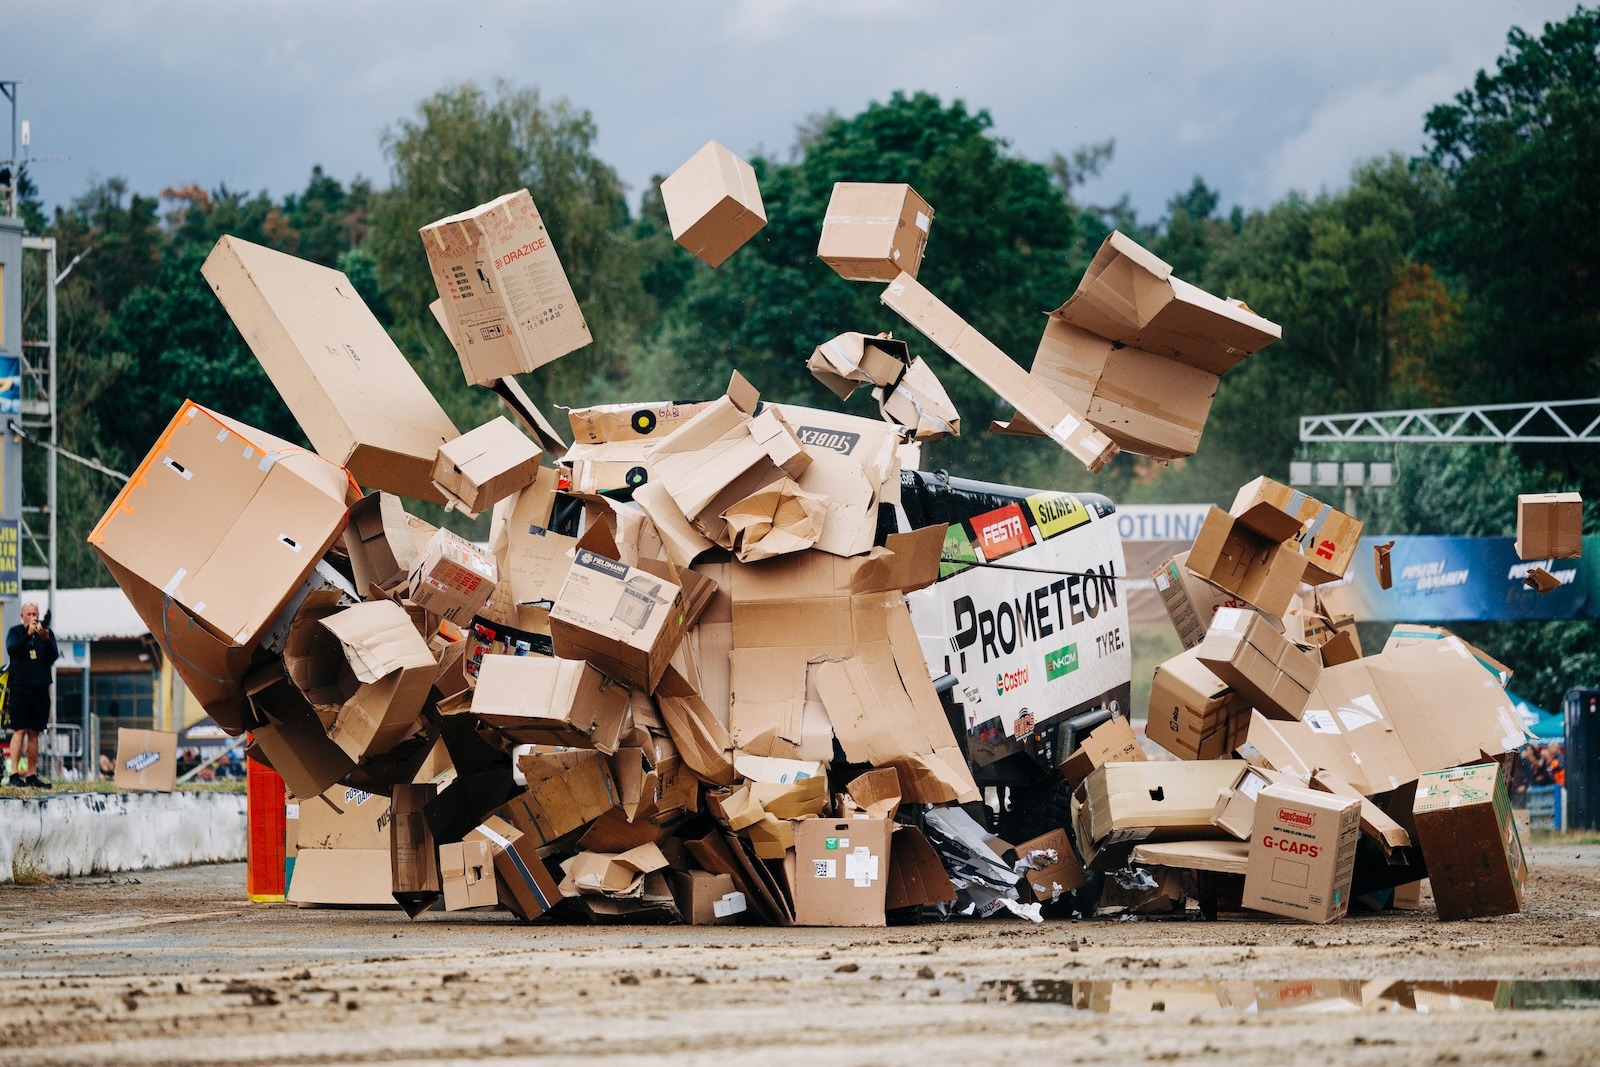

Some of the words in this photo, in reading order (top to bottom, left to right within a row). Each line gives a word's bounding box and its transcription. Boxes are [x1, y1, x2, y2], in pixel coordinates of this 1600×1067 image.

[503, 238, 547, 266] DRAŽICE
[801, 429, 848, 450] TUBEX
[1037, 496, 1078, 525] SILMET
[982, 515, 1024, 547] FESTA
[1117, 513, 1205, 539] OTLINA
[593, 557, 626, 574] FIELDMANN
[949, 560, 1118, 675] PROMETEON
[1095, 628, 1125, 659] TYRE.
[1003, 664, 1030, 692] Castrol
[1439, 770, 1477, 780] FRAILE
[1279, 809, 1312, 826] CapsCanada
[1263, 835, 1319, 858] G-CAPS
